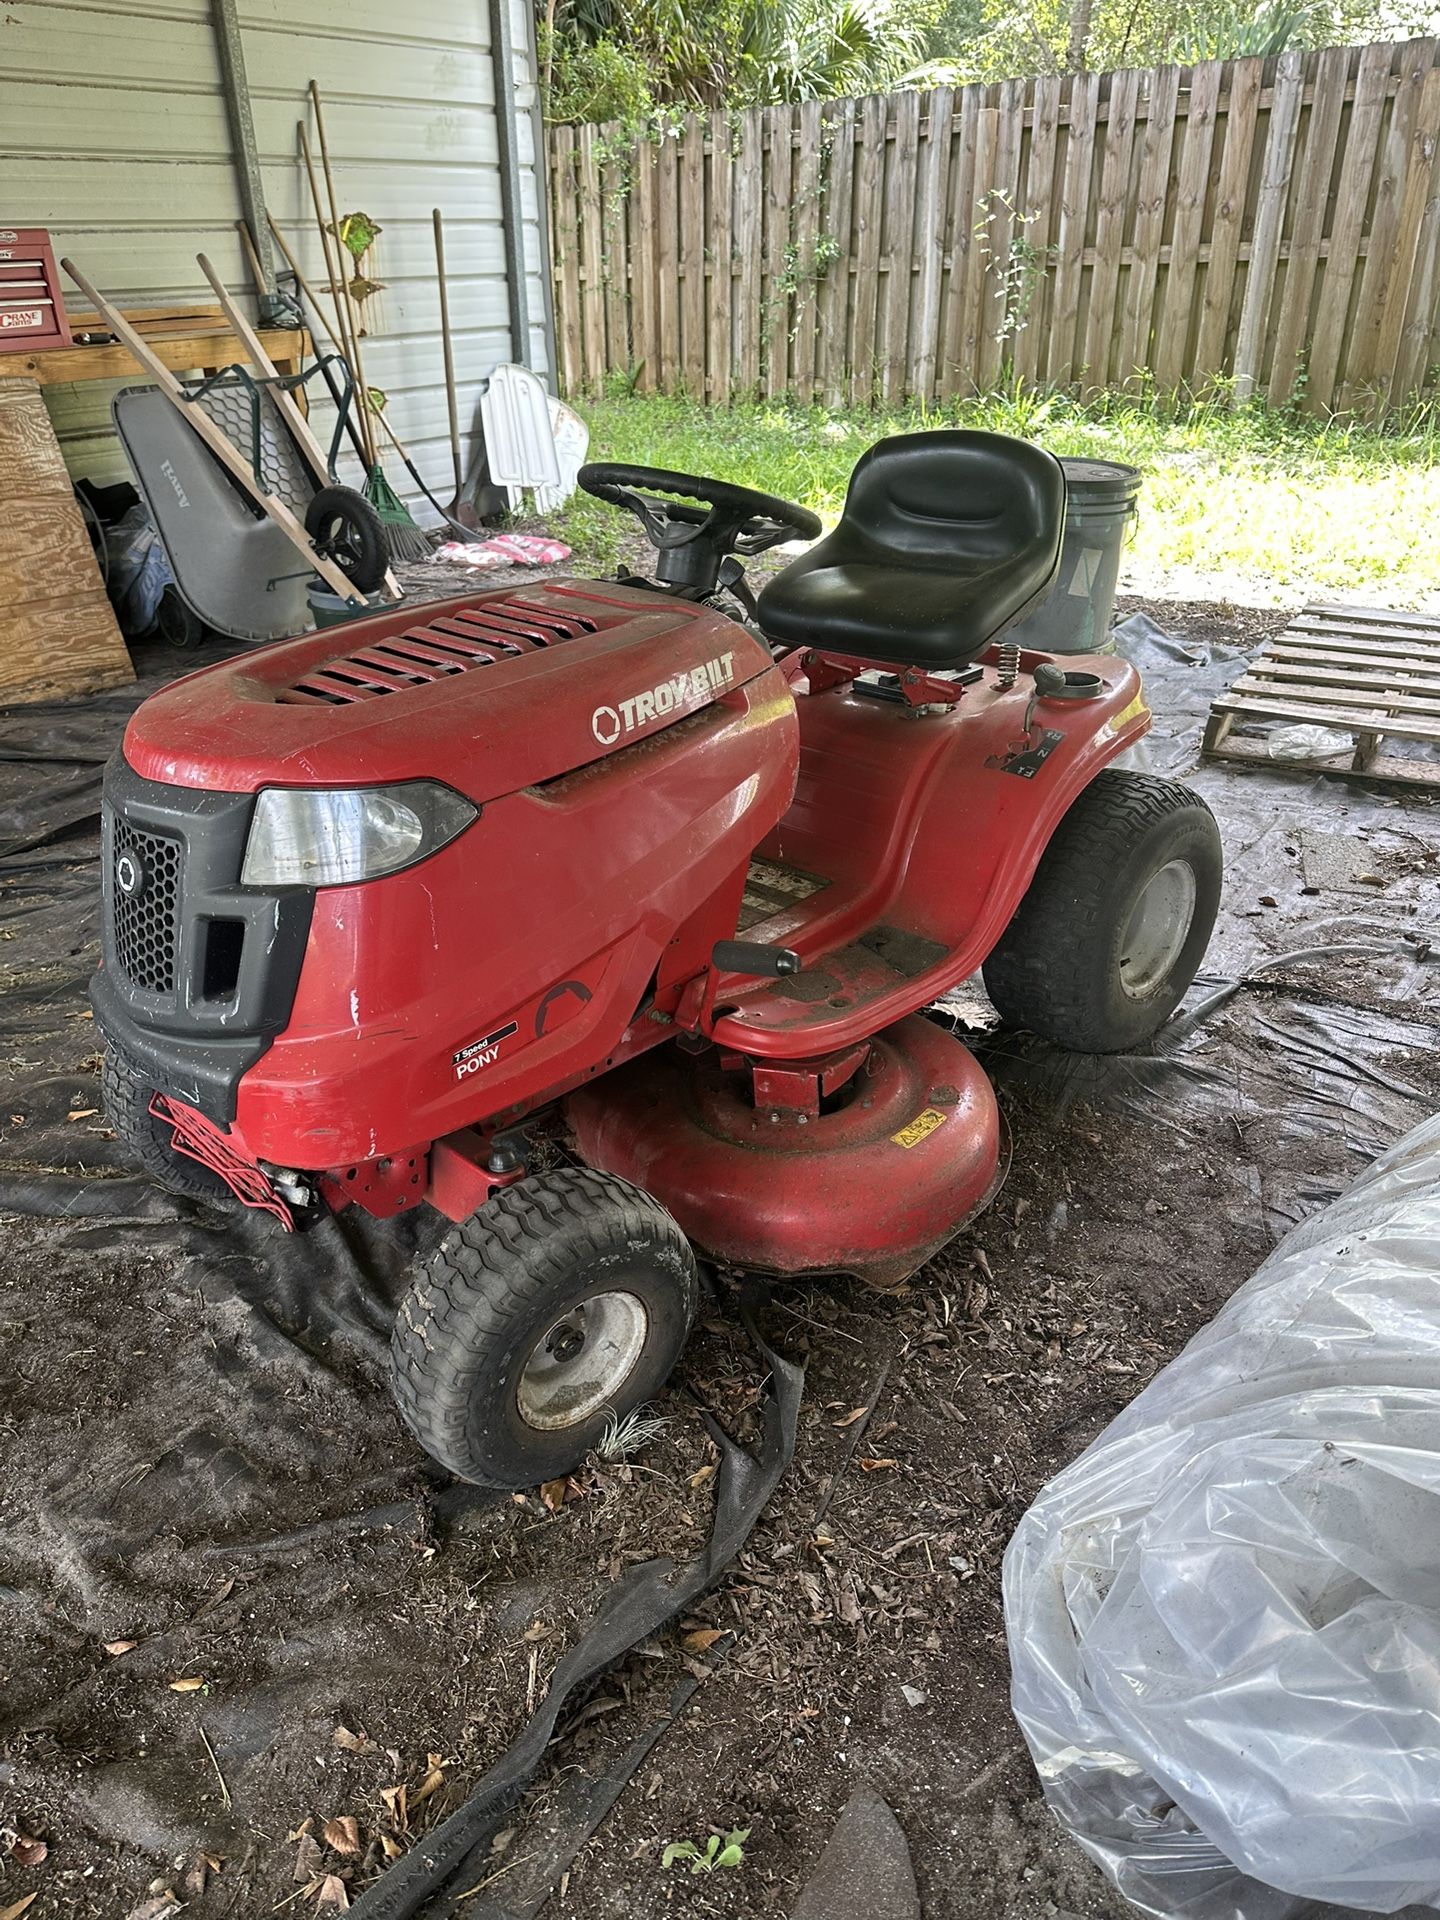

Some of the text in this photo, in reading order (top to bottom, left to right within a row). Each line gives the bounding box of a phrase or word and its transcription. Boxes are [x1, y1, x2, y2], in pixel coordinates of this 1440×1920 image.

[0, 312, 38, 327] CRANE
[160, 459, 191, 508] Anvil
[1037, 749, 1049, 758] N
[454, 1038, 488, 1062] 7 Speed
[456, 1044, 499, 1080] PONY
